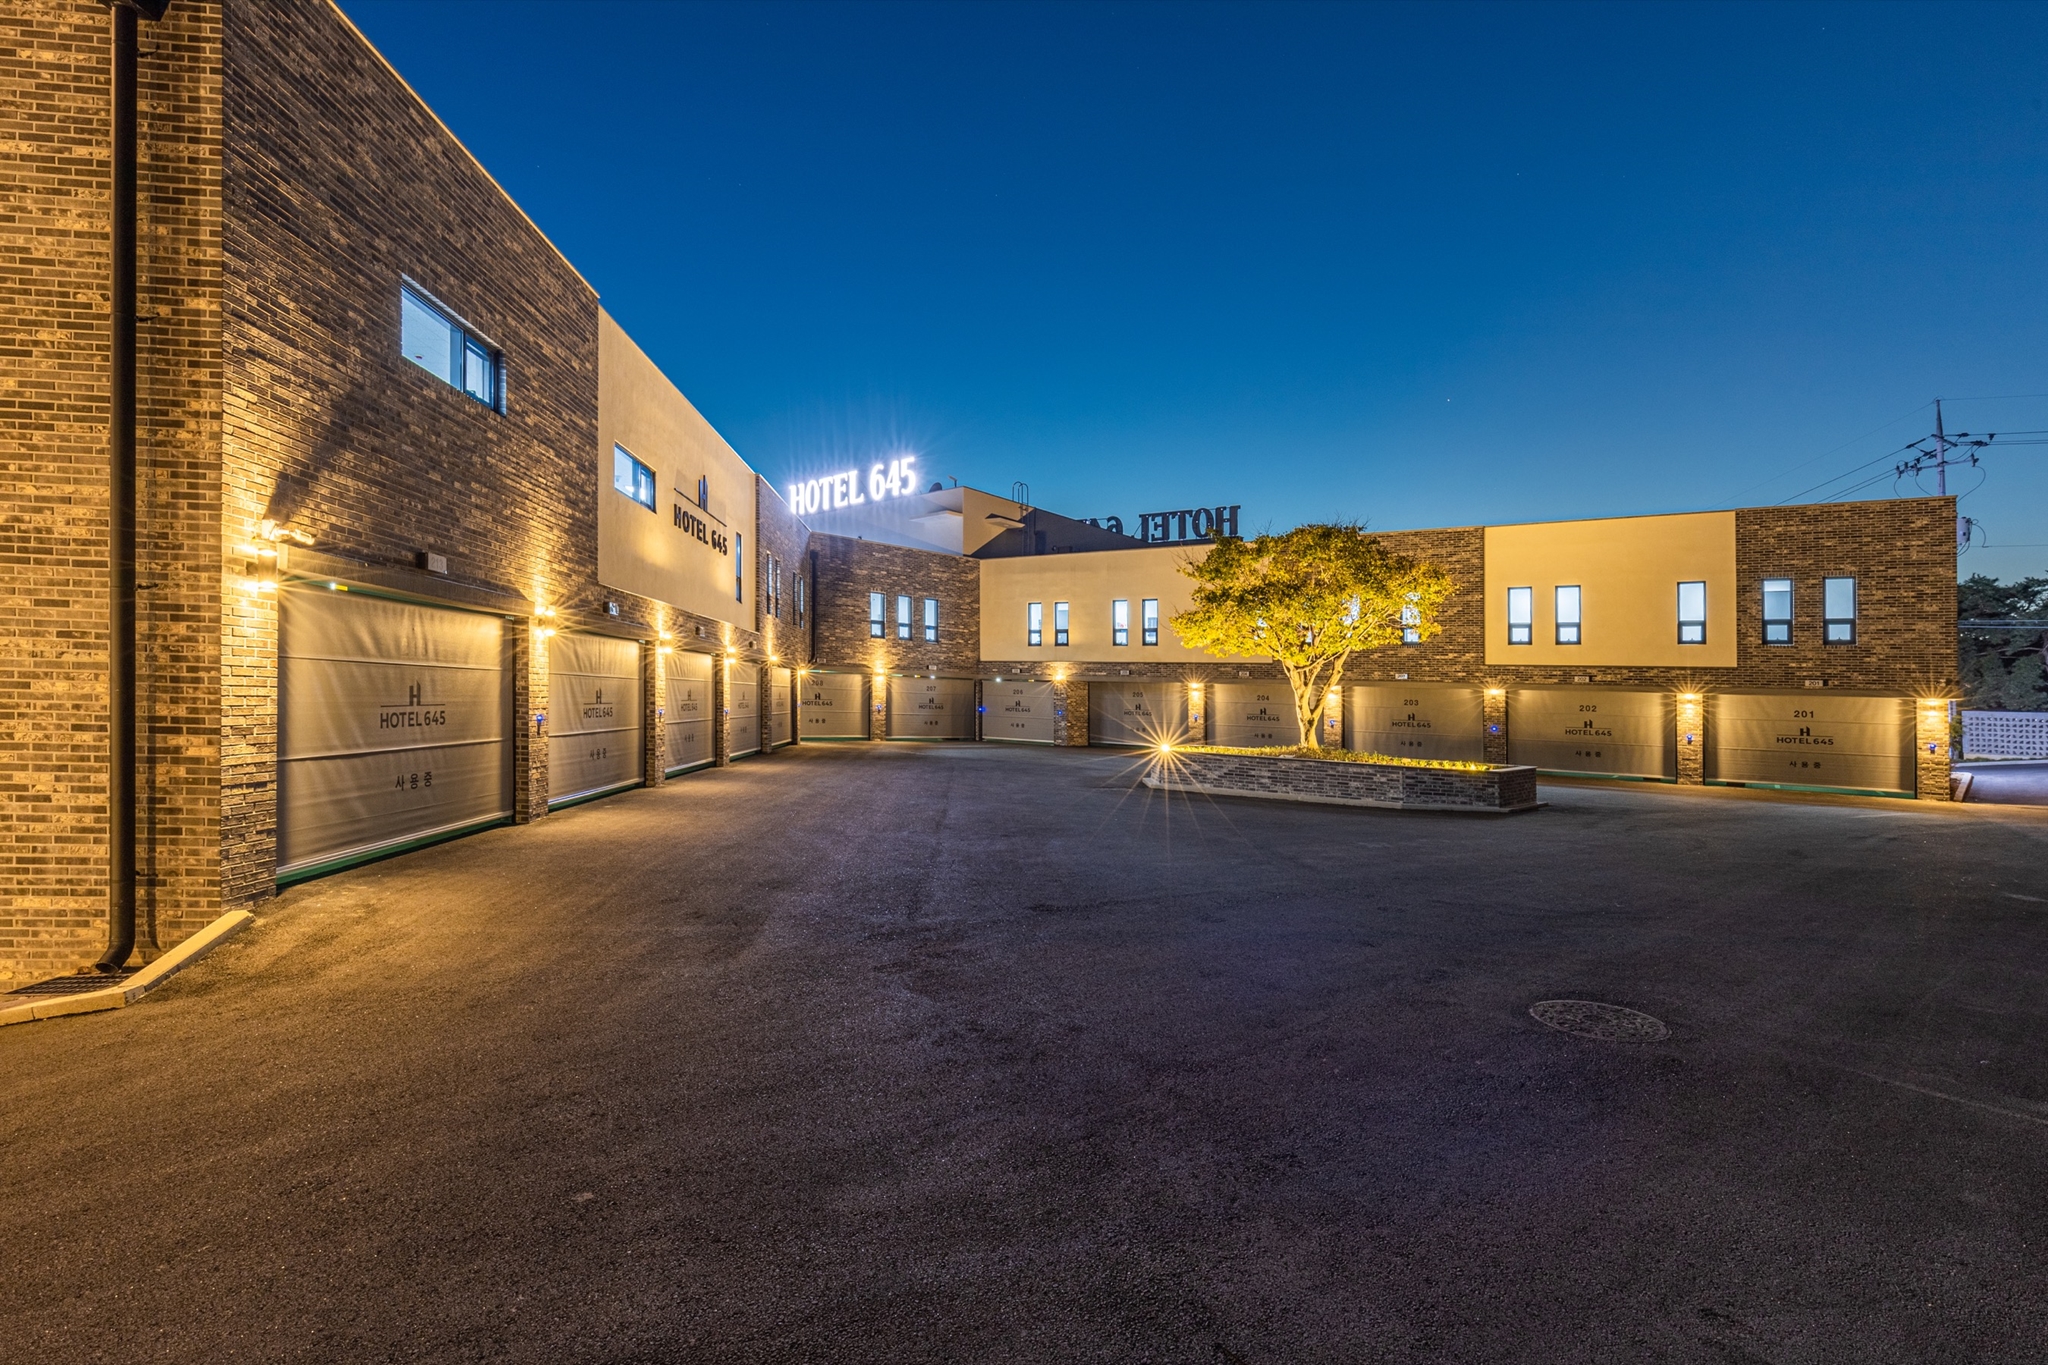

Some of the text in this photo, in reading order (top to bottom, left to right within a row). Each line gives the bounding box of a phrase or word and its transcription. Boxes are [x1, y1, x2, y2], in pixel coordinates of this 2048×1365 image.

[789, 456, 916, 515] HOTEL 645
[673, 503, 728, 556] HOTEL 645
[380, 710, 446, 729] HOTEL 645
[583, 707, 613, 719] HOTEL 645
[1794, 710, 1814, 718] 201
[1776, 737, 1834, 746] HOTEL 645
